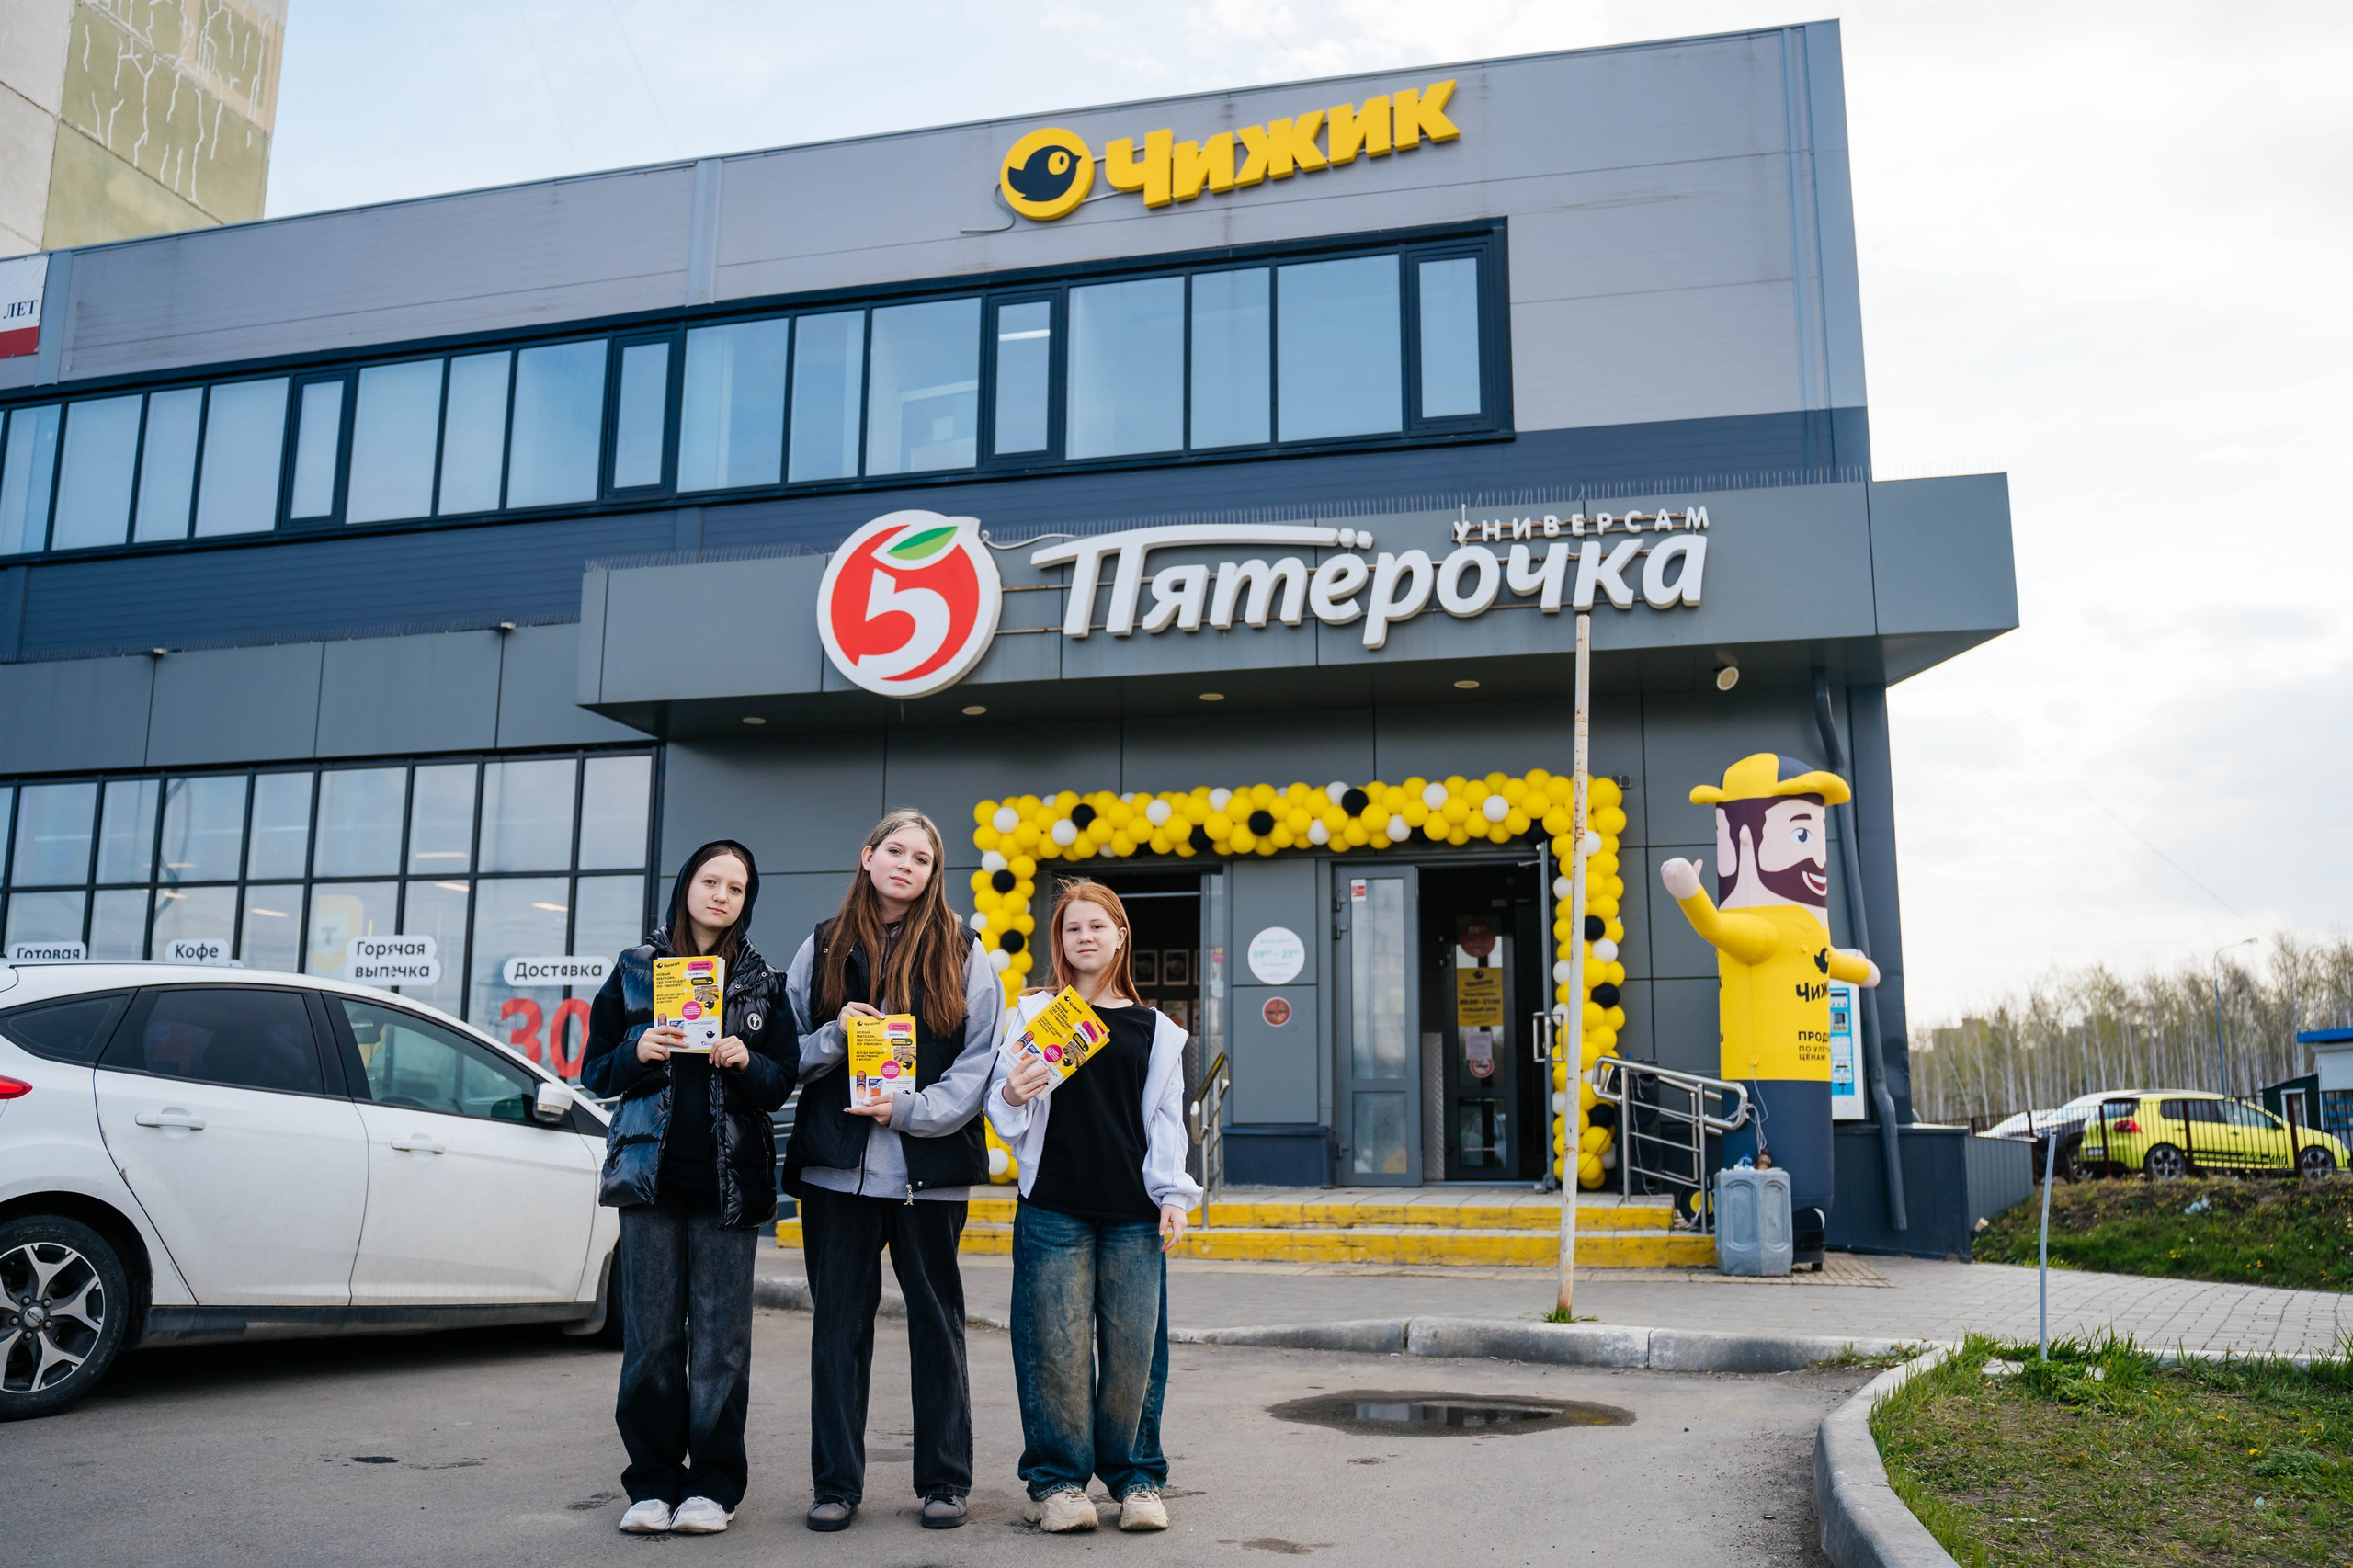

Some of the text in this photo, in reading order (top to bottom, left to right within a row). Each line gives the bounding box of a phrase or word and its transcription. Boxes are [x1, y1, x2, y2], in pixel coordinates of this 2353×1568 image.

[3, 300, 38, 319] ЛЕТ
[1452, 506, 1709, 542] УНИВЕРСАМ
[1030, 524, 1707, 650] Пятёрочка
[17, 947, 81, 959] Готовая
[175, 944, 219, 961] Кофе
[357, 941, 426, 959] Горячая
[355, 964, 430, 979] выпечка
[514, 963, 603, 980] Доставка
